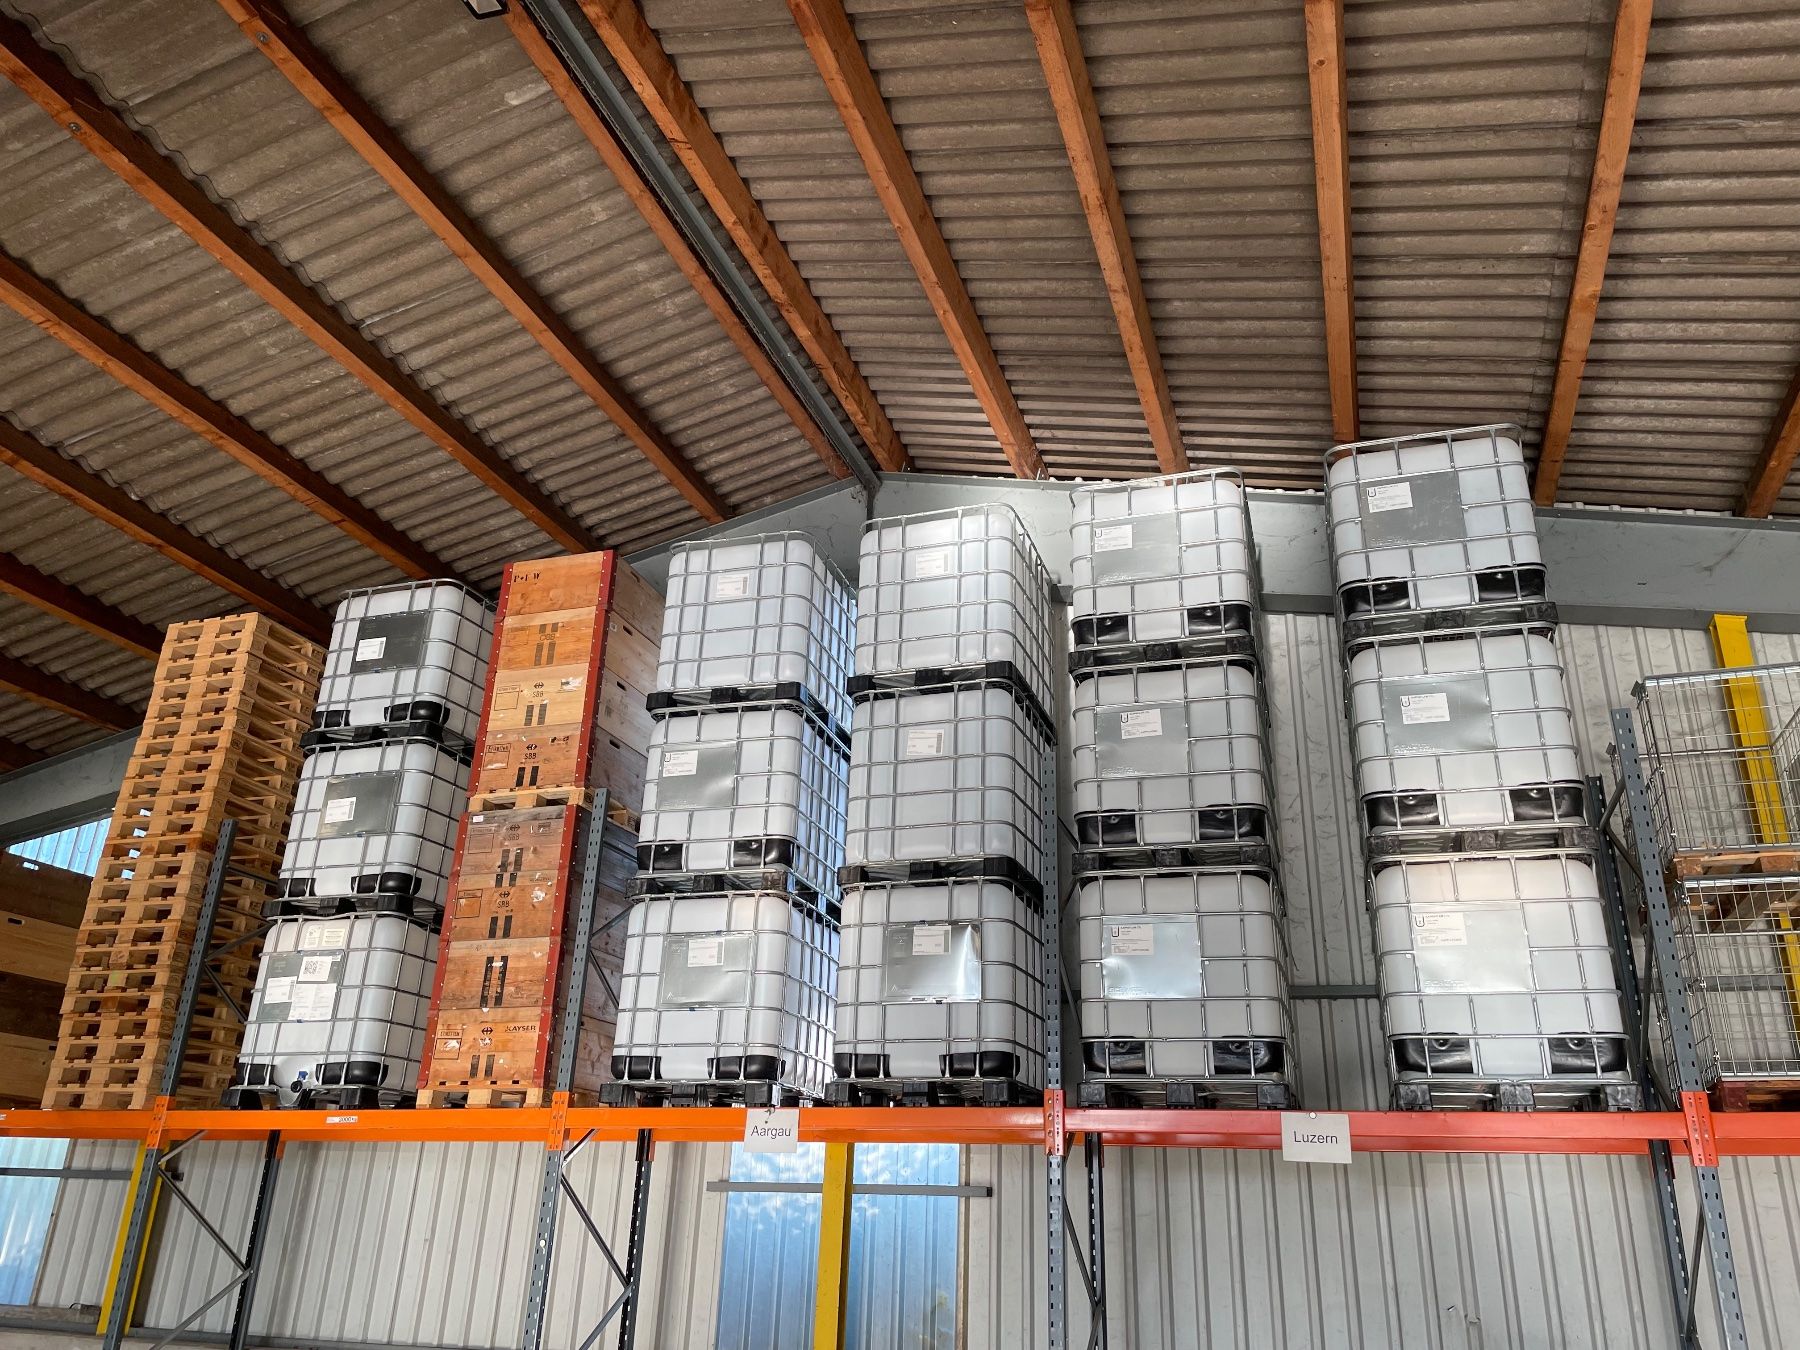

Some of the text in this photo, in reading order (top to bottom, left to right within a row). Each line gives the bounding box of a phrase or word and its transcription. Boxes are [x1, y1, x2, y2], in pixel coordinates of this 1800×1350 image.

[524, 752, 537, 760] SBB
[750, 1125, 791, 1139] Aargau
[1293, 1130, 1338, 1144] Luzern
